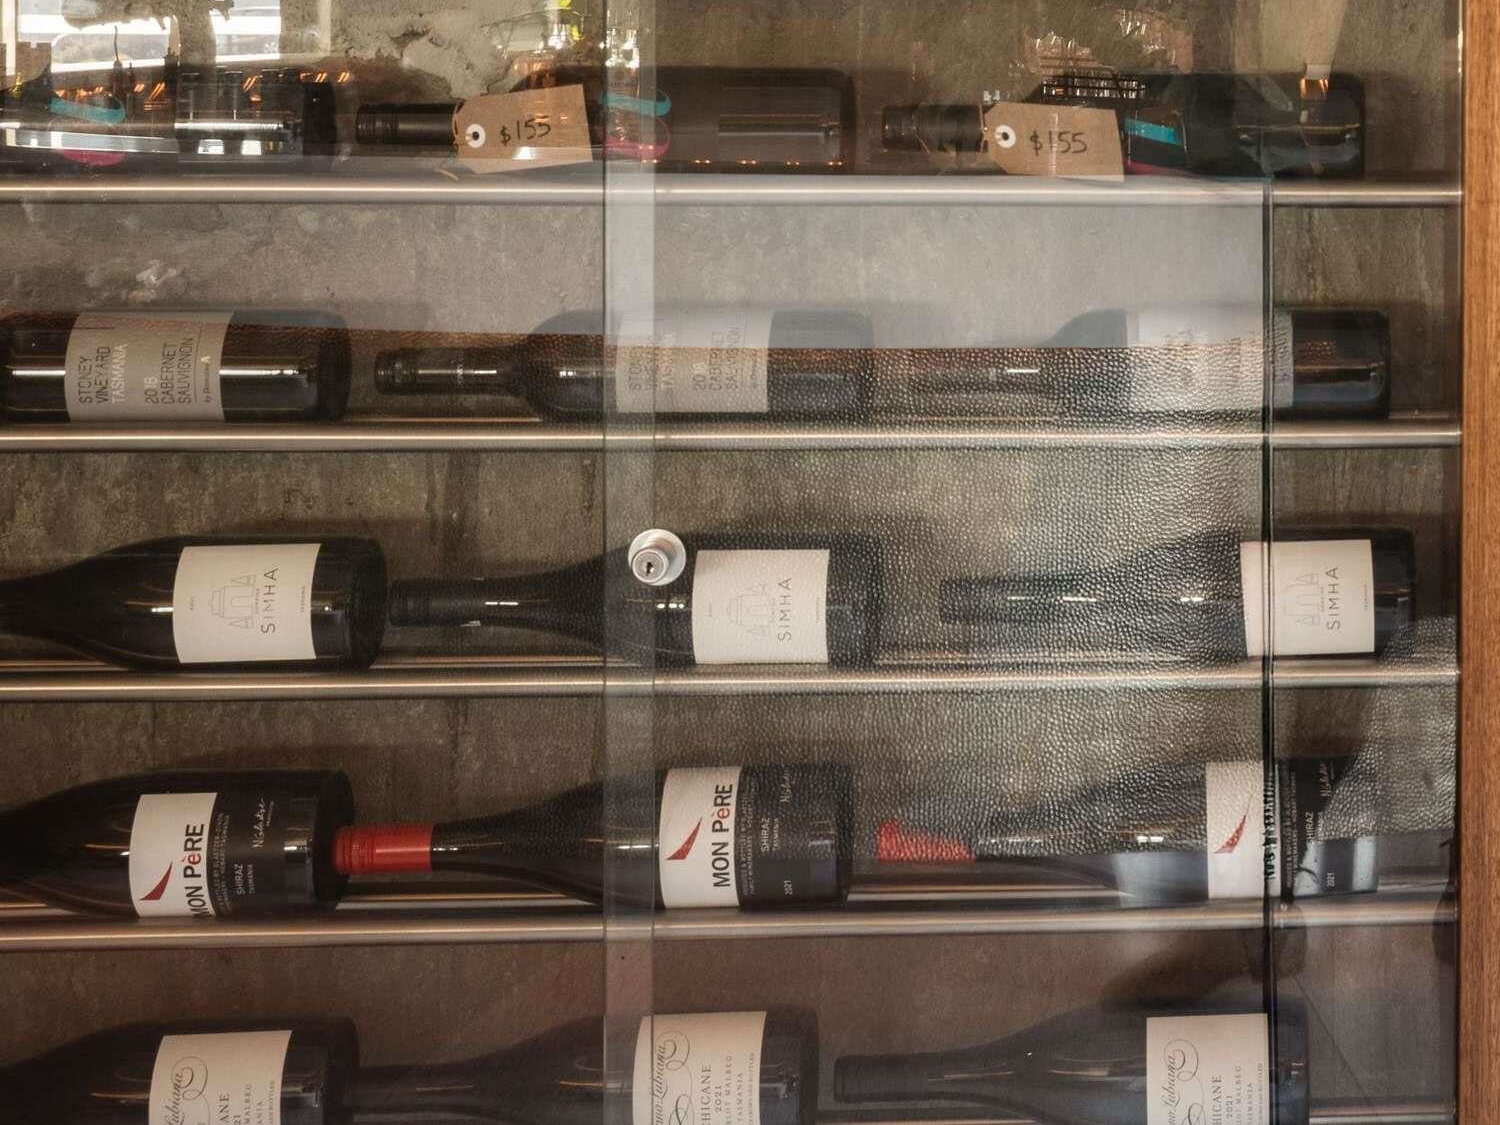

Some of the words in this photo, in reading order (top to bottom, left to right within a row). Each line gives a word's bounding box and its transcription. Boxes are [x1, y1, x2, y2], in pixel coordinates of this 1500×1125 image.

[500, 115, 551, 147] $155
[1030, 130, 1088, 155] $155
[78, 356, 93, 404] STONEY
[94, 346, 111, 404] VINEYARD
[111, 343, 128, 404] TASMANIA
[144, 375, 159, 404] 2018
[160, 342, 178, 405] CABERNET
[177, 337, 194, 404] SAUVIGNON
[260, 567, 278, 634] SIMHA
[777, 578, 792, 642] SIMHA
[1325, 566, 1341, 630] SIMHA
[760, 817, 770, 853] SHIRAZ
[1305, 811, 1314, 845] SHIRAZ
[234, 863, 246, 895] SHIRAZ
[711, 842, 731, 888] MON
[700, 1064, 711, 1125] HICANE
[714, 1084, 722, 1114] 2021
[1225, 1095, 1233, 1119] 2021
